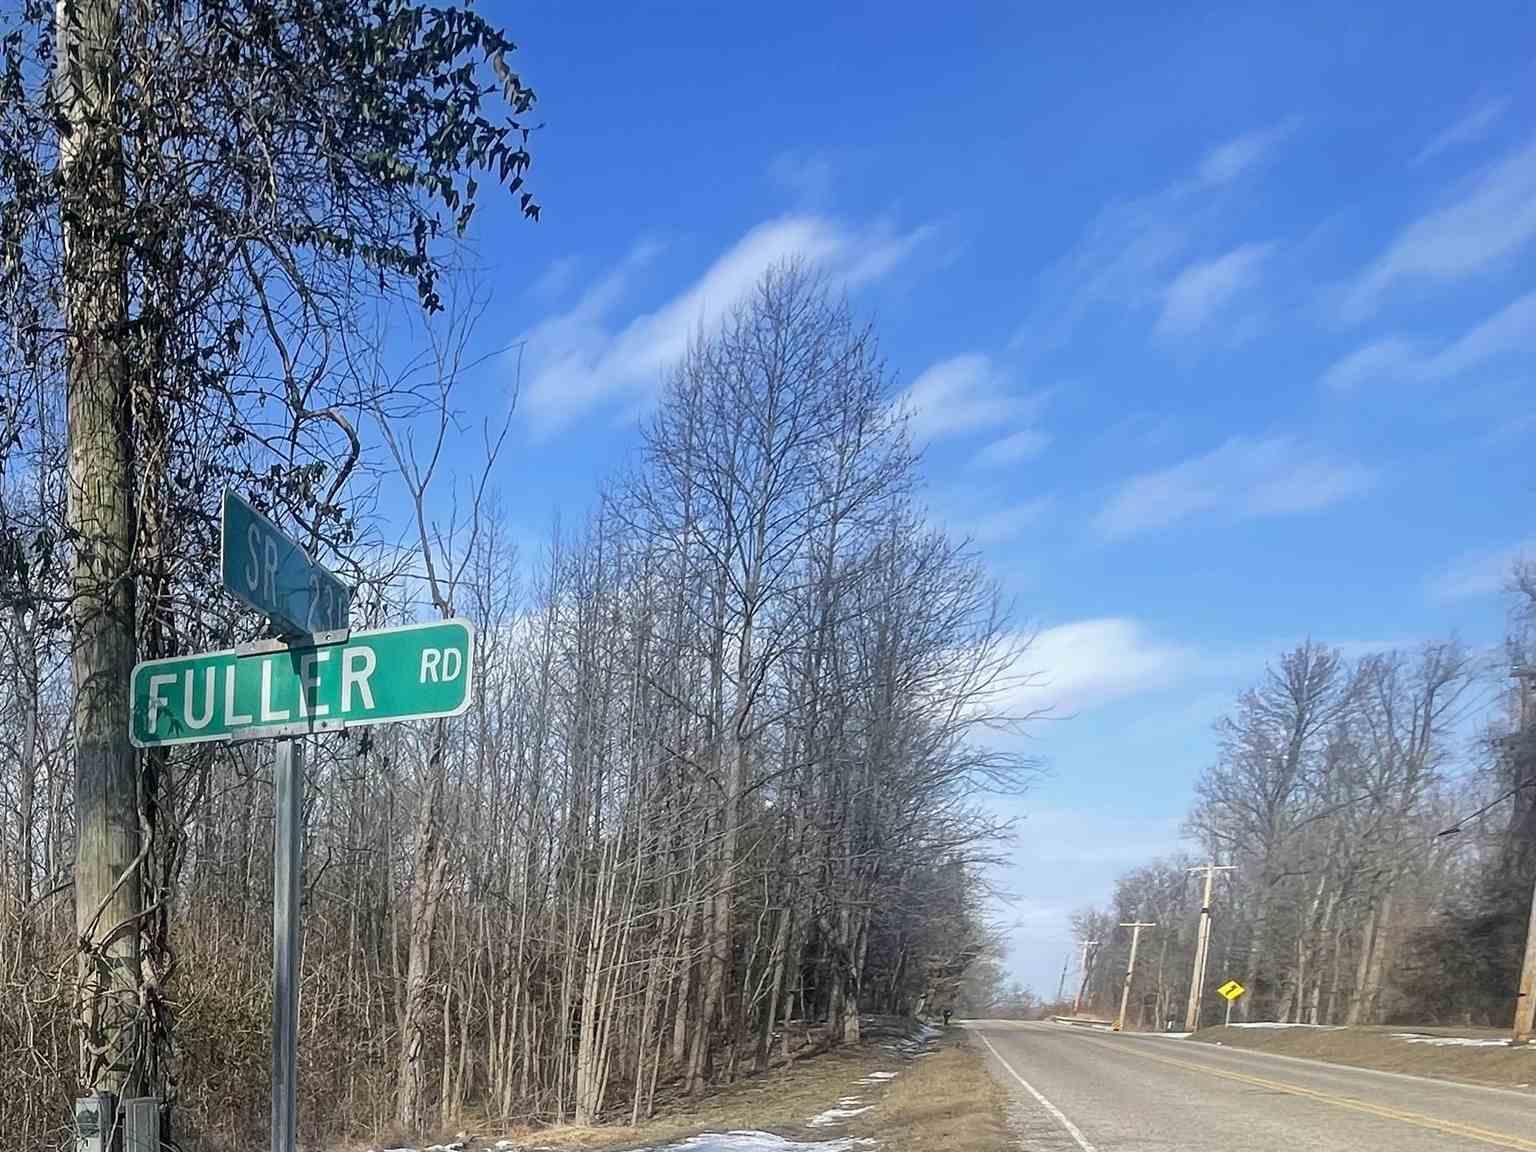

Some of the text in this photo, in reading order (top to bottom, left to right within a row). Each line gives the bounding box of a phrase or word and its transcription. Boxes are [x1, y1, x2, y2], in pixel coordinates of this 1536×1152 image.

[245, 522, 278, 608] SR
[148, 645, 462, 734] FULLER RD
